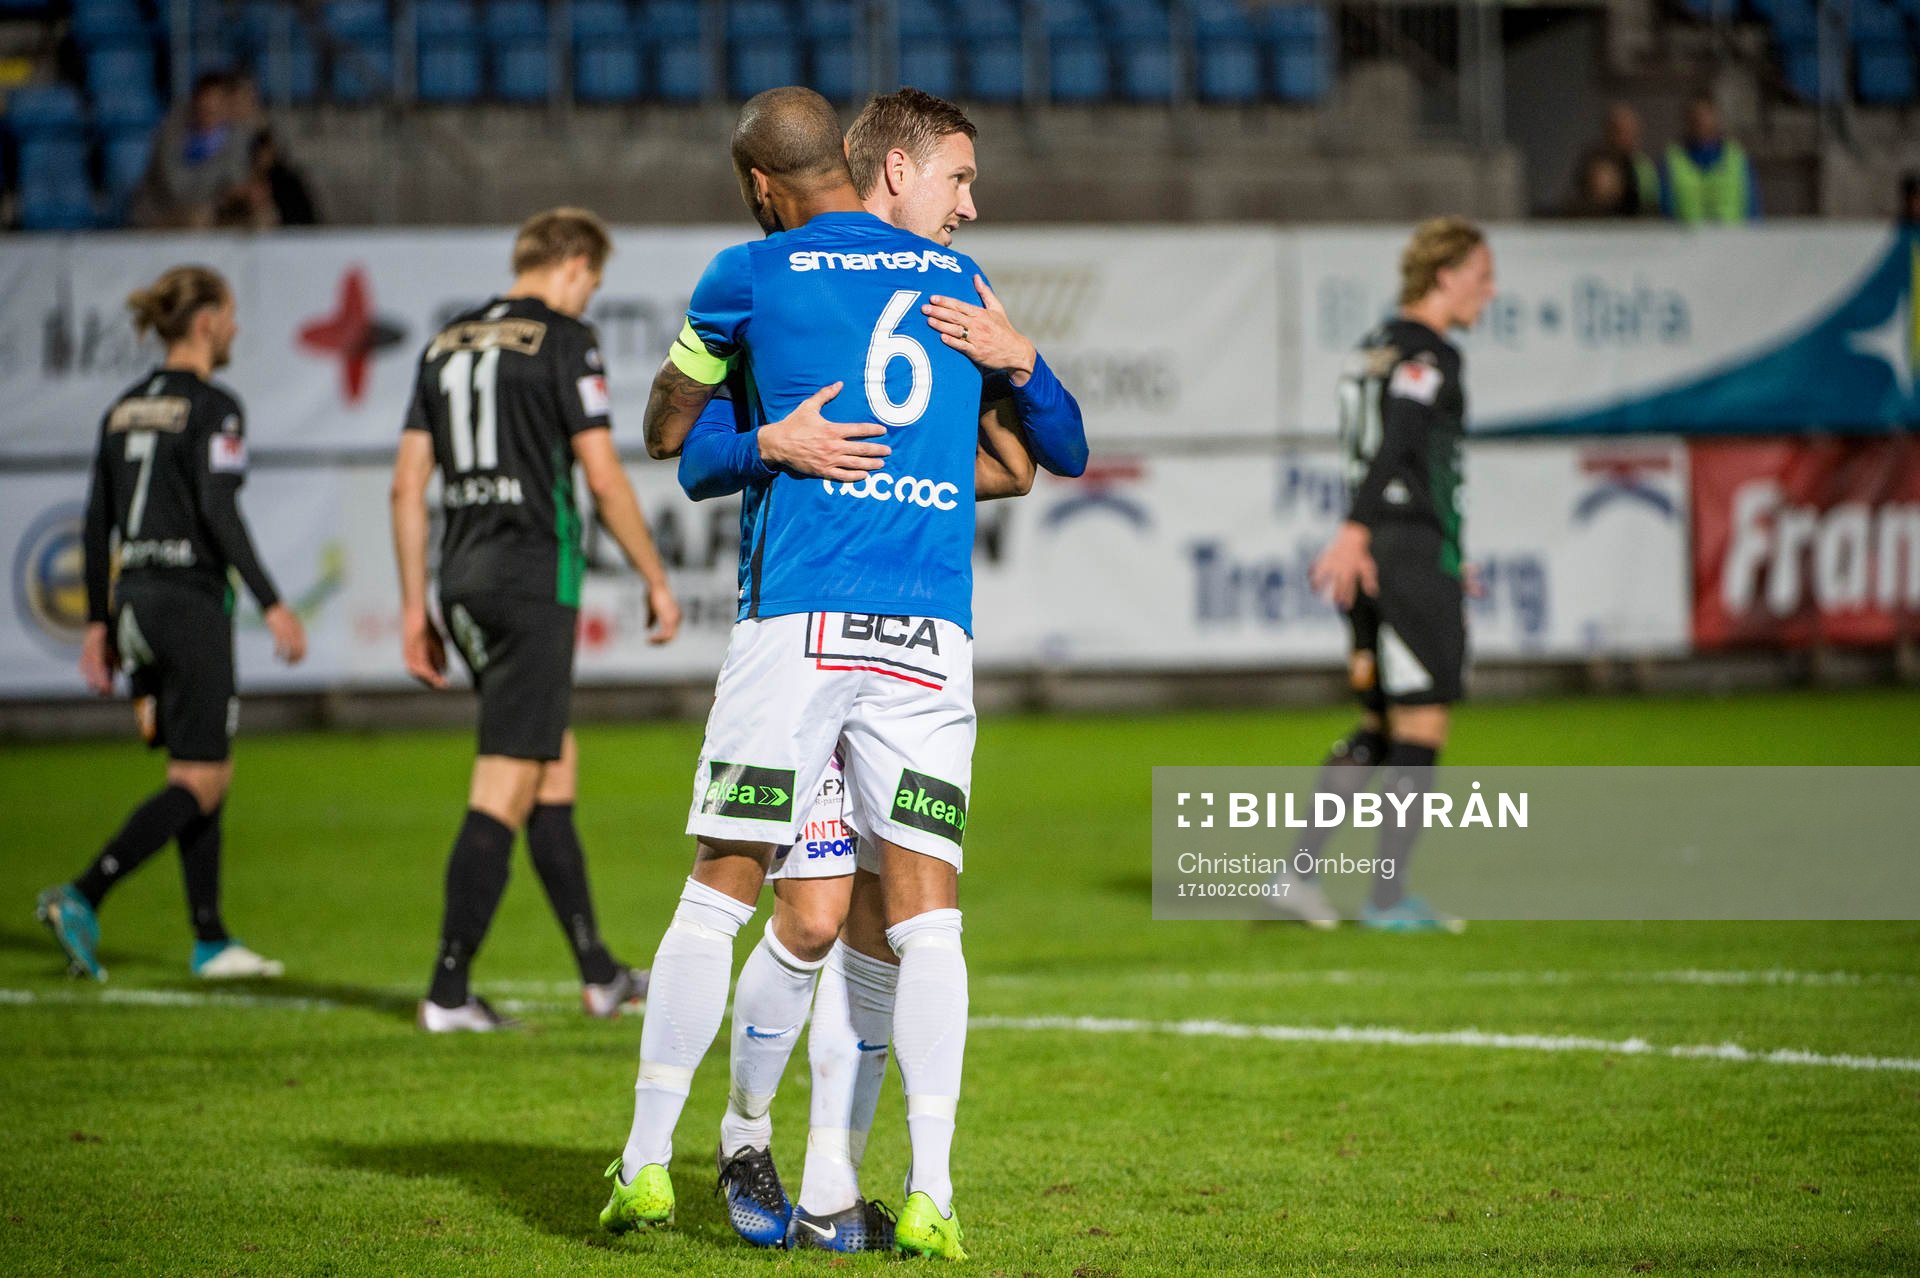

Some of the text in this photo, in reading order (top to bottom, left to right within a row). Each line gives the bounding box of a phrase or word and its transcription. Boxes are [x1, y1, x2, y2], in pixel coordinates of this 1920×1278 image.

[789, 250, 962, 273] smarteyes
[865, 290, 932, 427] 6
[438, 346, 500, 474] 11
[124, 428, 157, 541] 7
[841, 612, 940, 656] BCA
[707, 780, 756, 805] akea
[896, 786, 957, 825] akea
